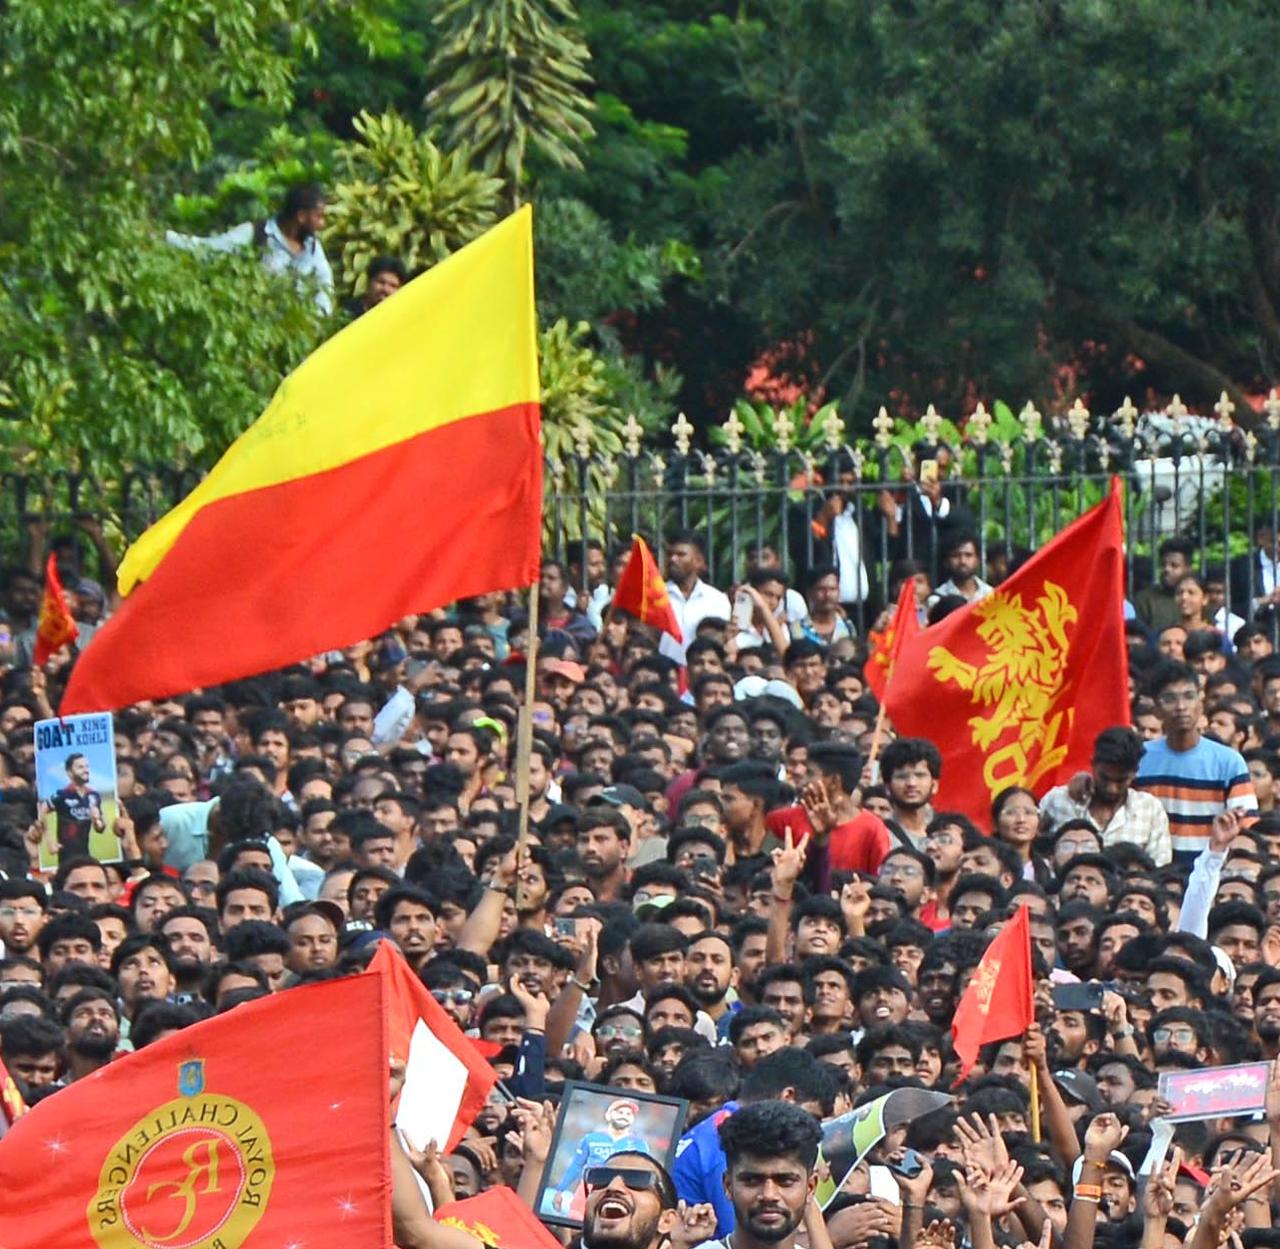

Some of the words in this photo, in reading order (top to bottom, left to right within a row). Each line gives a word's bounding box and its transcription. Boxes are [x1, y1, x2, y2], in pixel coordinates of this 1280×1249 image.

[37, 723, 75, 750] GOAT
[81, 718, 108, 732] KING
[76, 731, 108, 746] KOHLI
